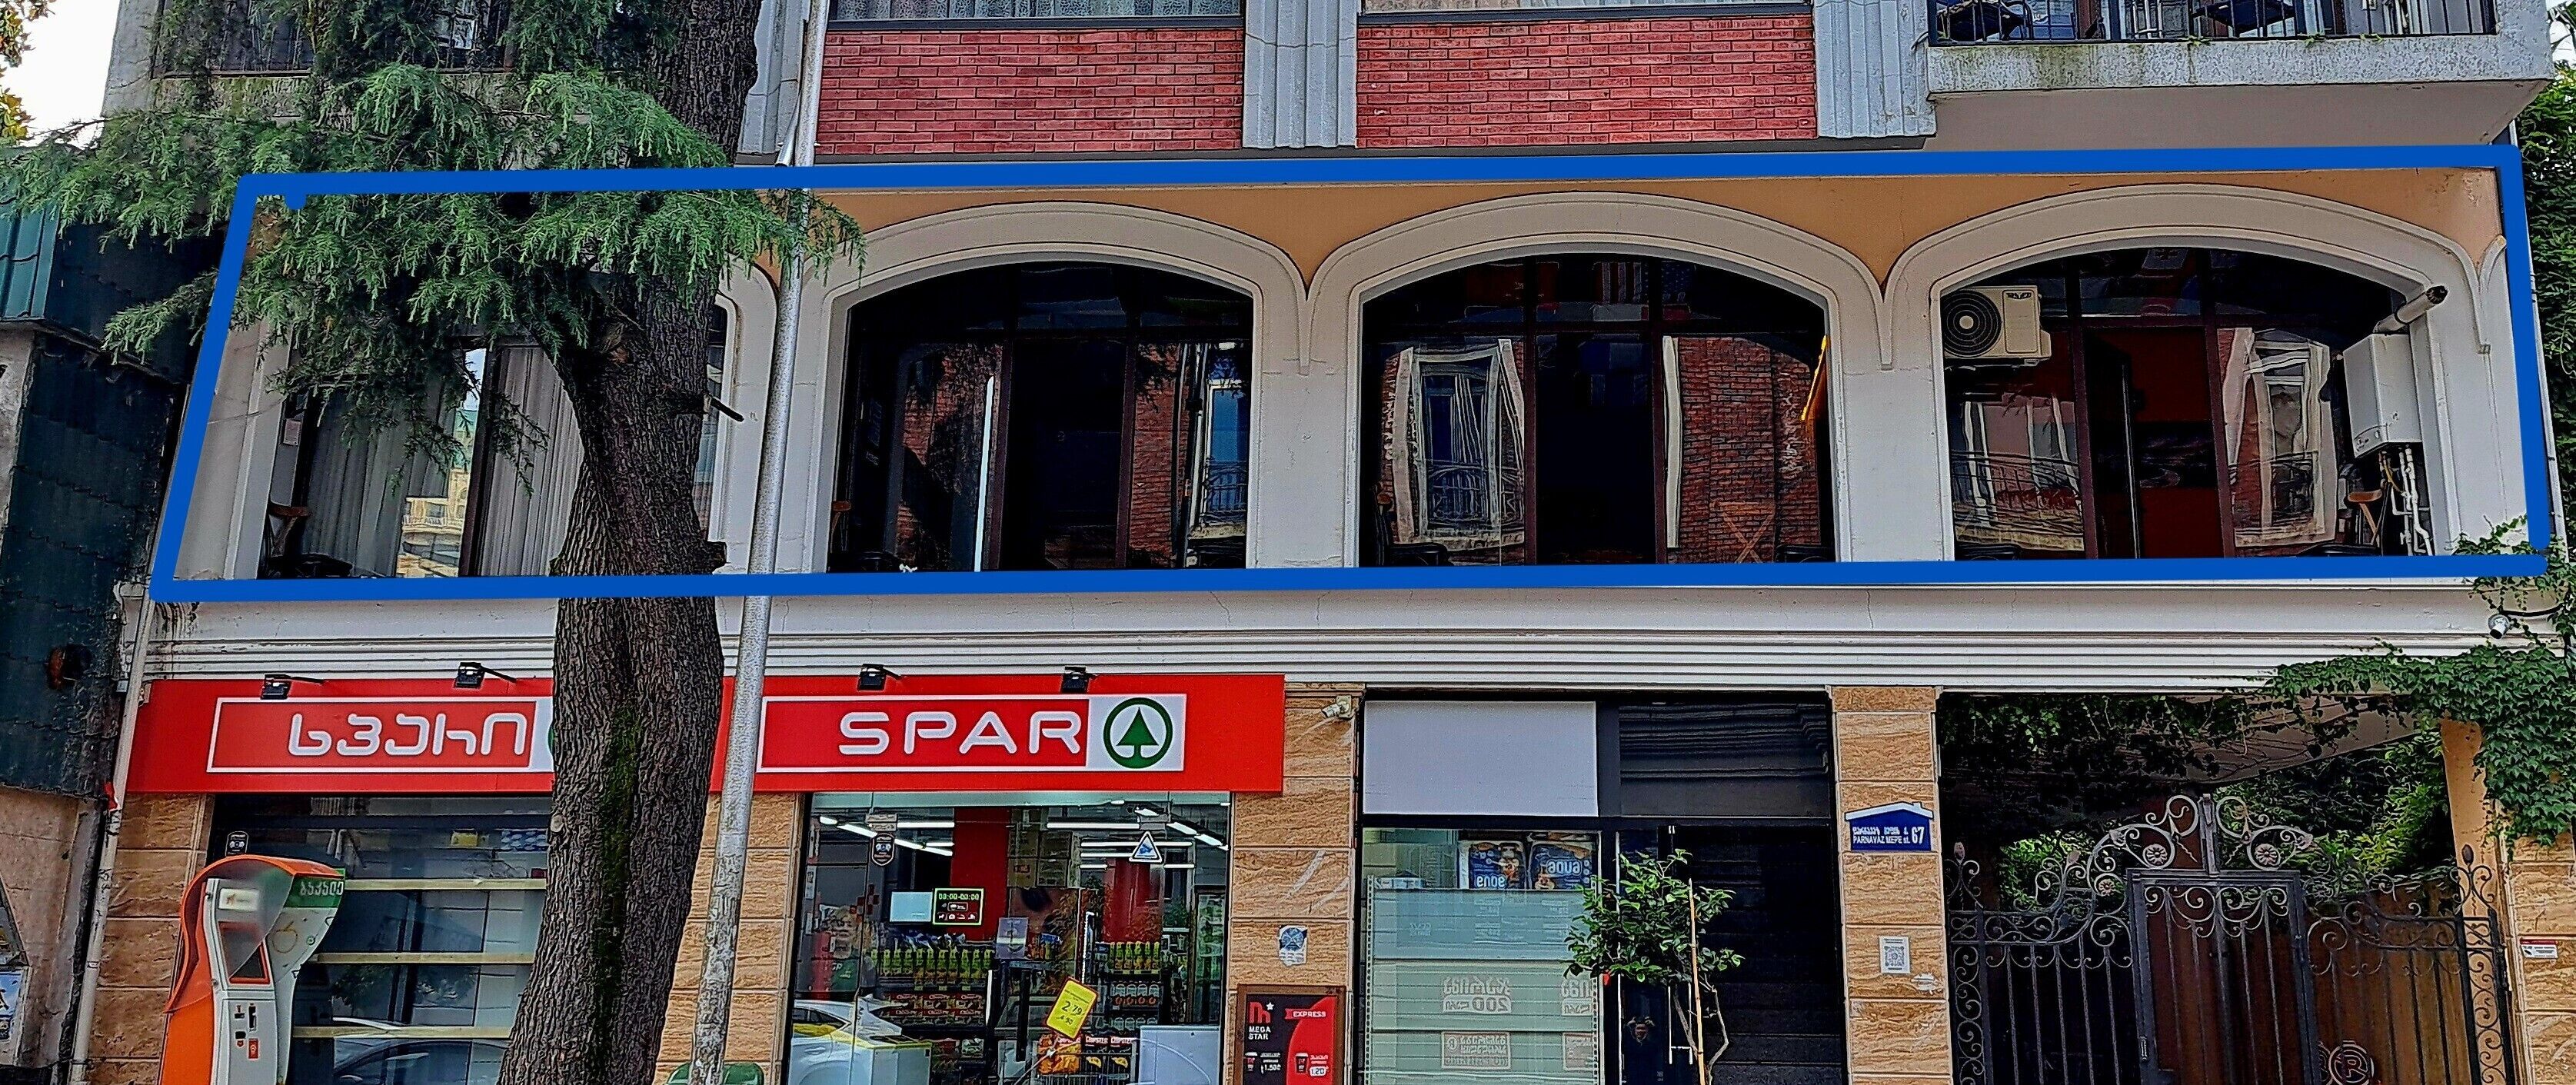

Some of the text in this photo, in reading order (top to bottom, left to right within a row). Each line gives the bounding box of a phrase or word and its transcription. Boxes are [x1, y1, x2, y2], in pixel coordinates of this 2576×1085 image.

[838, 711, 1081, 756] SPAR
[1852, 835, 1885, 844] PARNAVAZ
[1911, 826, 1925, 844] 67
